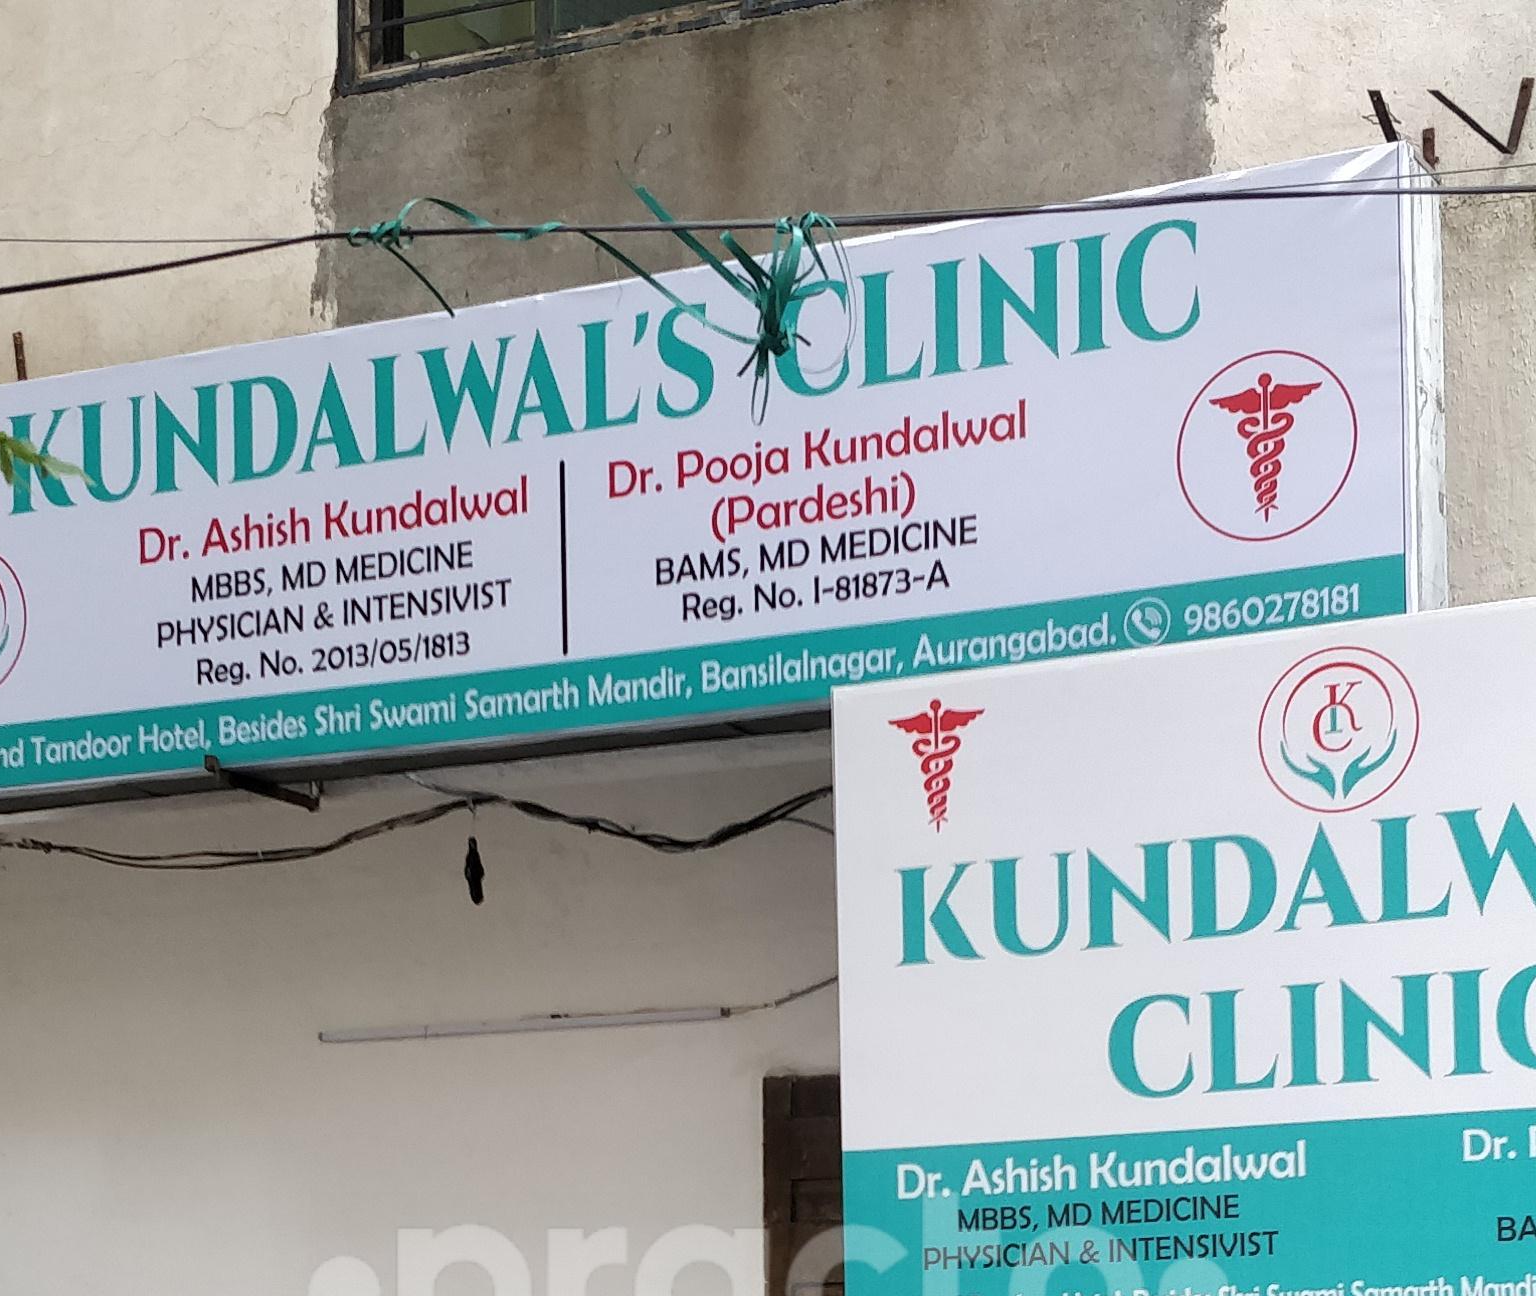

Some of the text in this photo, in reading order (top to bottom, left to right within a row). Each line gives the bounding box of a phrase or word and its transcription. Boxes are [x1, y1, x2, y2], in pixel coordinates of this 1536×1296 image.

[6, 218, 1202, 517] KUNDALWAL'S CLINIC
[608, 398, 1026, 499] Dr. Pooja Kundalwal
[139, 474, 528, 565] Dr. Ashish Kundalwal
[711, 470, 916, 544] (Pardeshi)
[191, 539, 474, 603] MBBS, MD MEDICINE
[655, 513, 978, 587] BAMS, MD MEDICINE
[156, 578, 512, 649] PHYSICIAN & INTENSIVIST
[682, 558, 950, 623] Reg. No. I-81873-A
[1183, 582, 1360, 636] 9860278181
[30, 730, 133, 766] Tandoor
[137, 718, 212, 754] Hotel,
[218, 709, 308, 747] Besides
[313, 703, 362, 737] Shri
[368, 692, 457, 731] Swami
[464, 677, 580, 721] Samarth
[587, 665, 693, 707] Mandir,
[700, 646, 904, 694] Bansilalnagar,
[912, 611, 1117, 669] Aurangabad.
[196, 630, 471, 686] Reg. No. 2013/05/1813
[896, 1138, 1307, 1200] Dr. Ashish Kundalwal
[1462, 1128, 1518, 1162] Dr.
[957, 1193, 1240, 1233] MBBS, MD MEDICINE
[923, 1230, 1280, 1271] PHYSICIAN & INTENSIVIST
